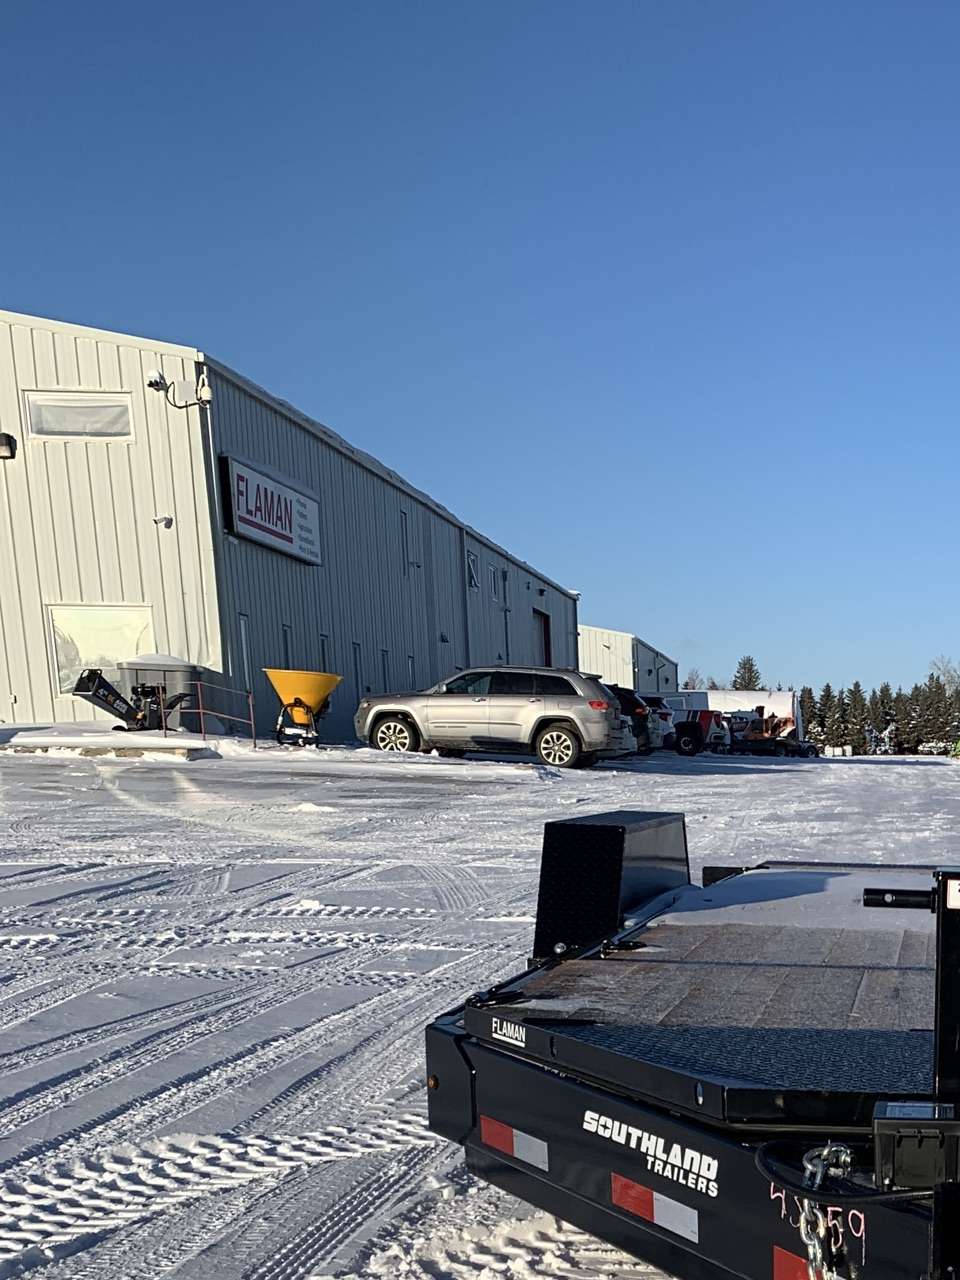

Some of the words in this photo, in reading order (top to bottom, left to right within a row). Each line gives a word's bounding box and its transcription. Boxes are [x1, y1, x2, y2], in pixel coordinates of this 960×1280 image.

[236, 472, 293, 534] FLAMAN
[492, 1017, 526, 1042] FLAMAN
[583, 1110, 719, 1180] SOUTHLAND
[646, 1156, 719, 1198] TRAILERS
